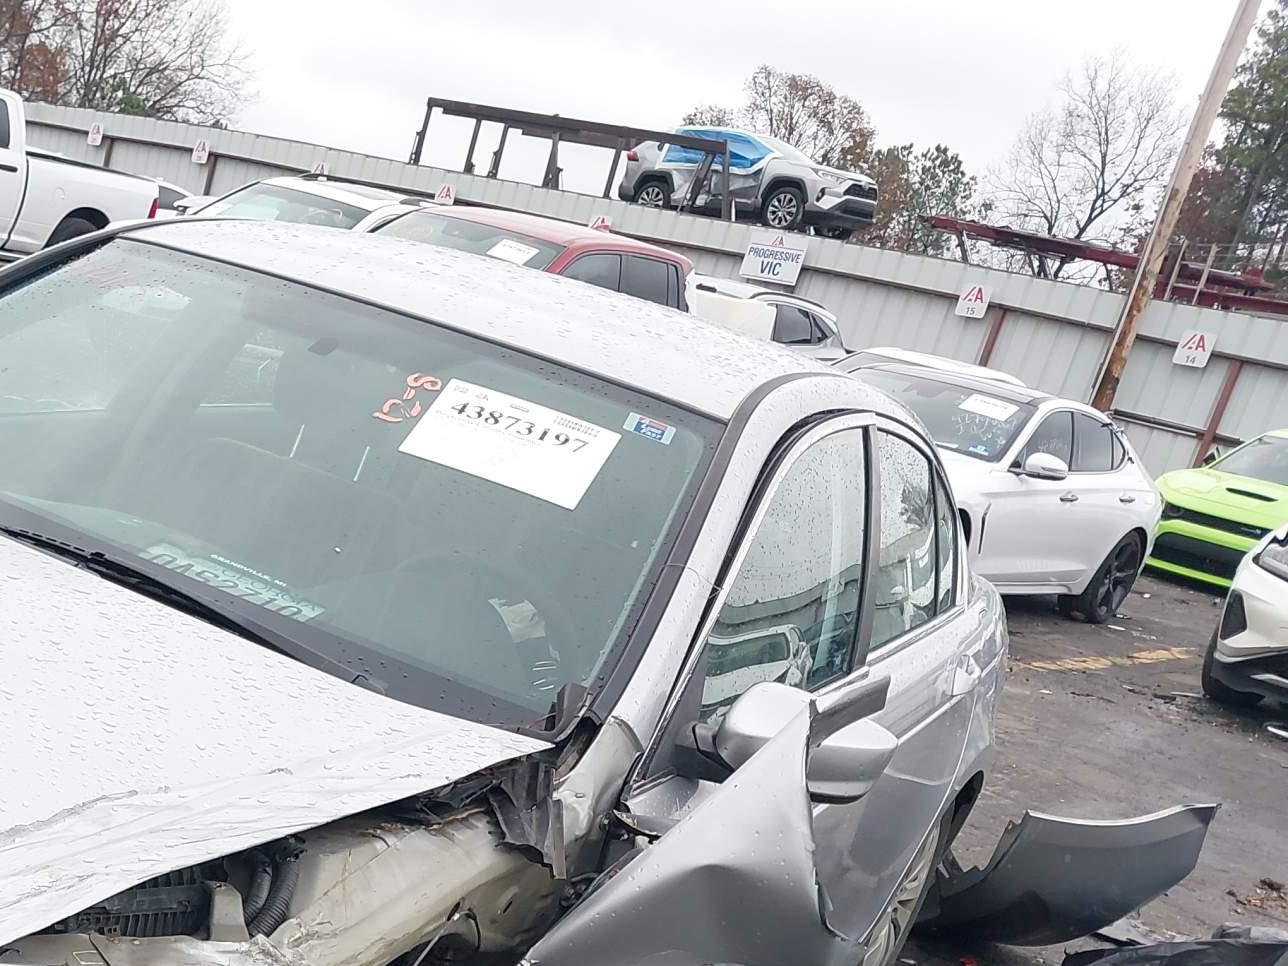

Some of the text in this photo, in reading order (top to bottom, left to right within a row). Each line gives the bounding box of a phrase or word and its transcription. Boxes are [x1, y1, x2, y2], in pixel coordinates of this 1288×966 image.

[747, 246, 803, 264] PROGRESSIVE
[760, 260, 783, 276] VIC
[966, 306, 977, 316] 15
[1185, 355, 1198, 365] 14
[451, 401, 590, 453] 43873197
